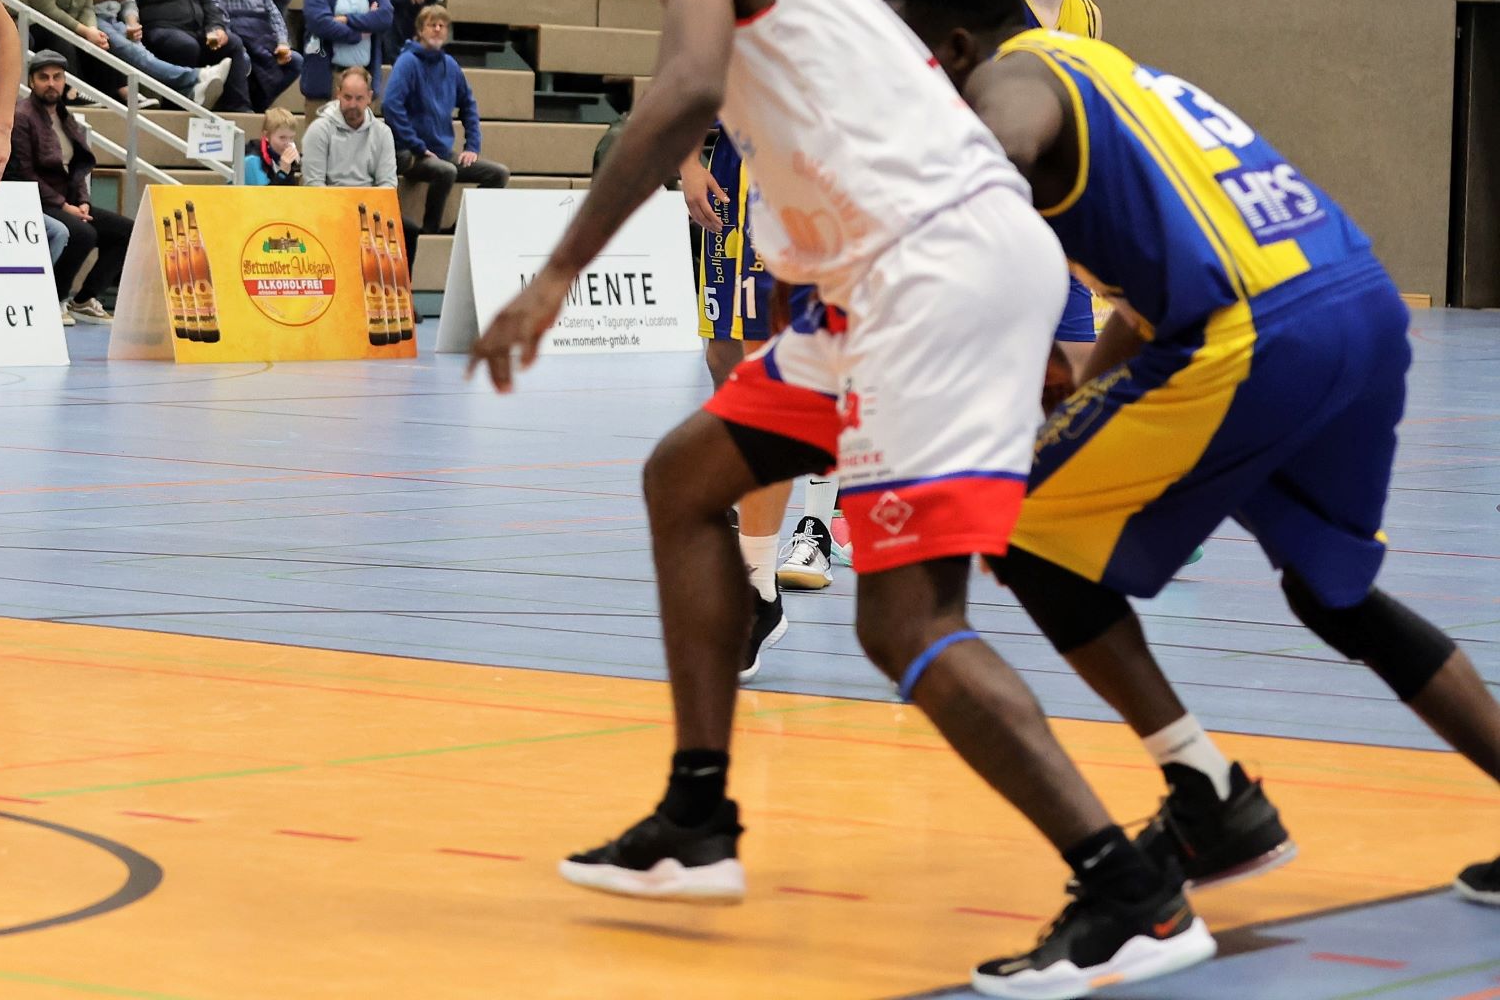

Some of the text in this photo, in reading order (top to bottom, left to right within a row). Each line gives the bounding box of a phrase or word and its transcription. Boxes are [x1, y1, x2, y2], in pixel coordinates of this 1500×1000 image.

[290, 256, 332, 280] Weizen
[257, 279, 324, 290] ALKOHOLFREI
[563, 314, 678, 330] Catering Tagungen Locations
[553, 333, 640, 349] www.momente-gmbh.de
